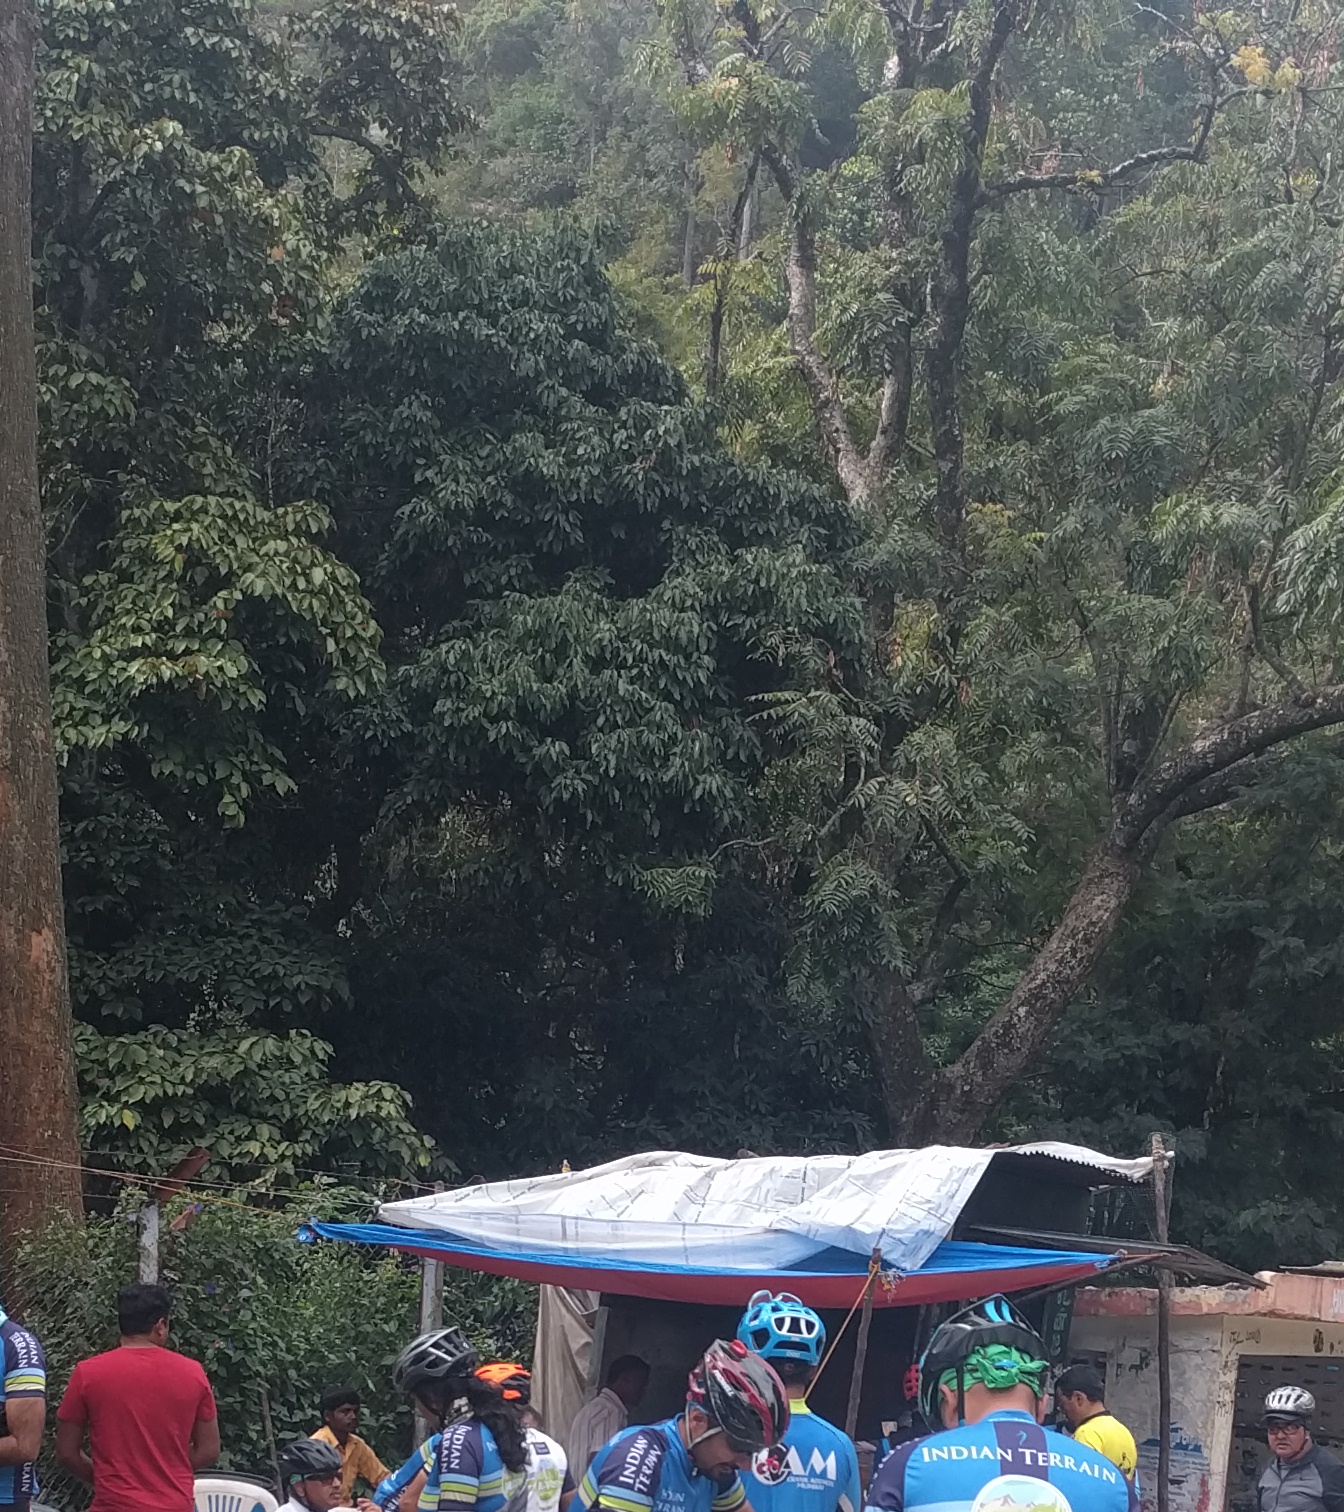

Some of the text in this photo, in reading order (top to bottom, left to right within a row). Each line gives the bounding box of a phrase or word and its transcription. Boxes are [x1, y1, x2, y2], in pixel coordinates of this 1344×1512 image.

[619, 1435, 650, 1485] INDIAN
[921, 1445, 1118, 1485] INDIAN TERRAIN
